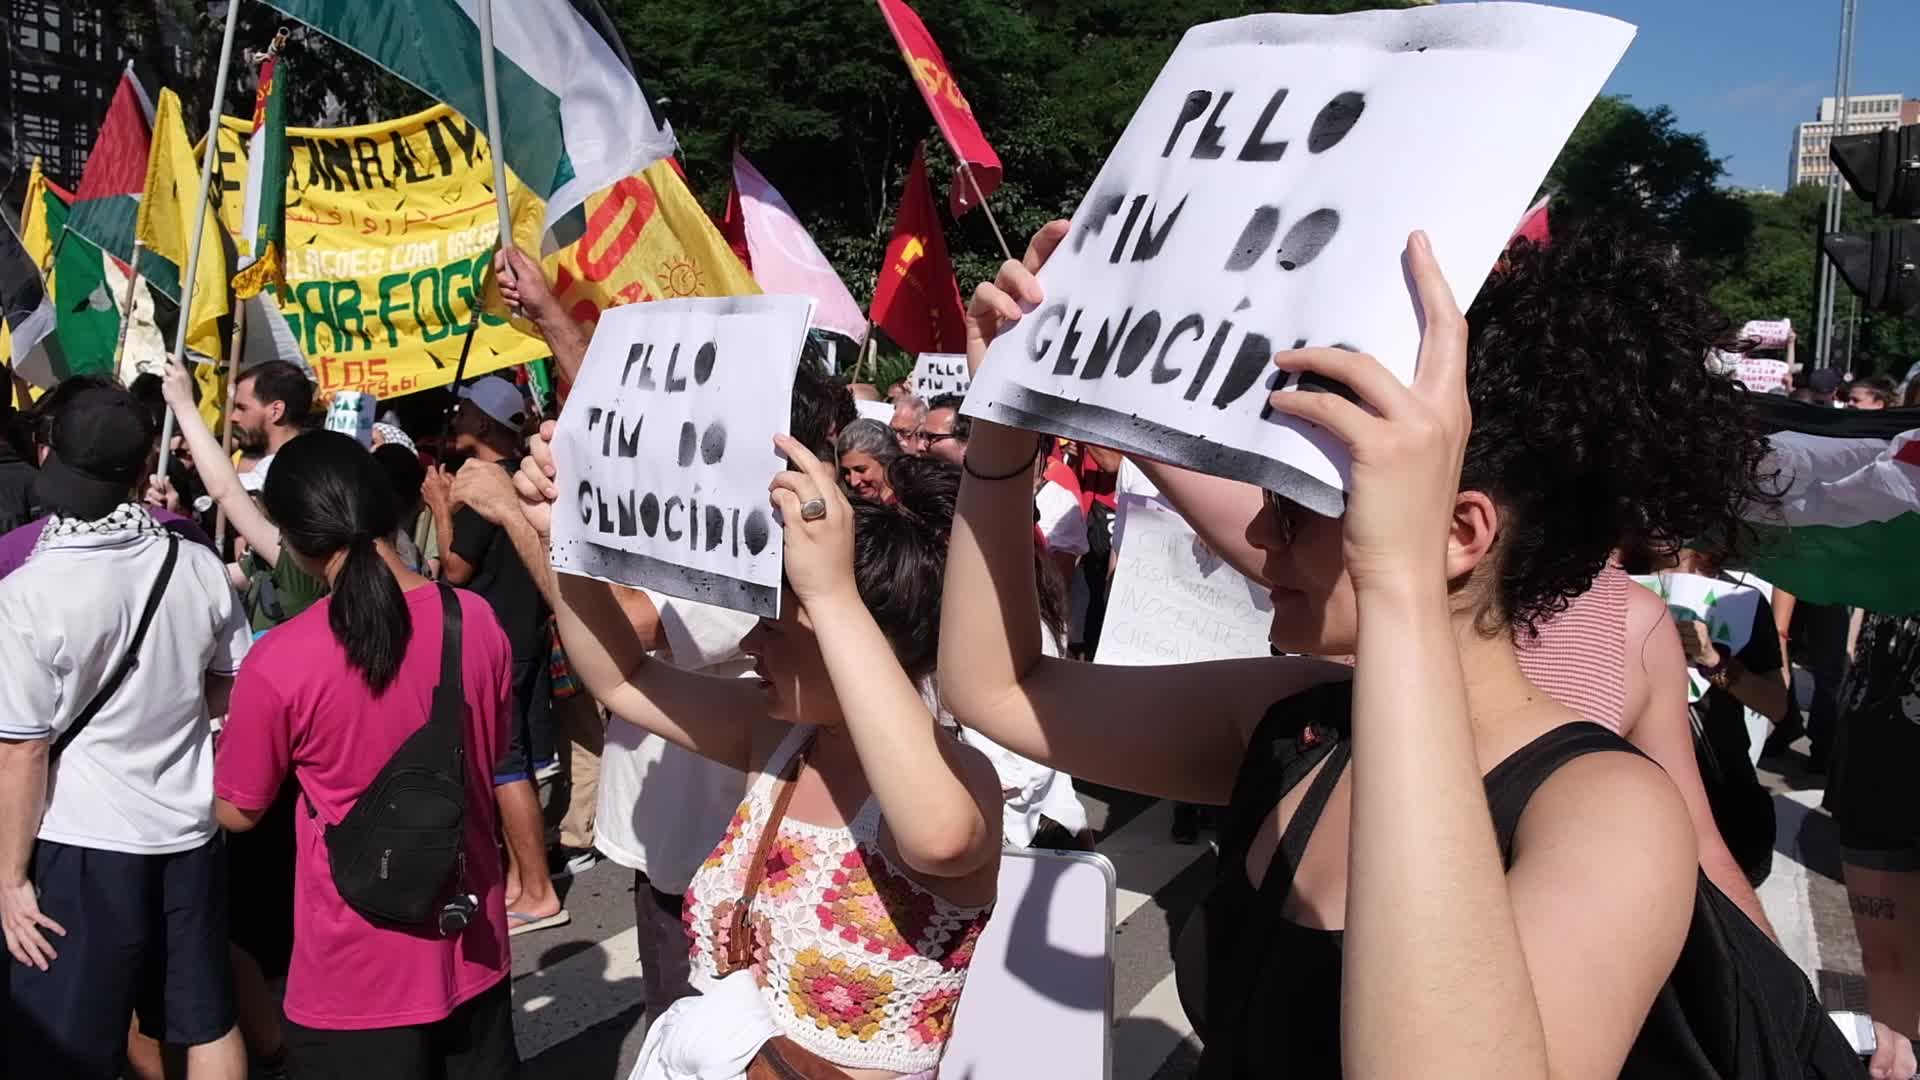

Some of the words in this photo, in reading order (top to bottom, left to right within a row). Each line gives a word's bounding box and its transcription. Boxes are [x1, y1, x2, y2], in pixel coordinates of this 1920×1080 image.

[1162, 89, 1366, 162] PELO
[1073, 192, 1189, 264] FIM
[1224, 205, 1342, 272] DO
[621, 336, 717, 393] PELO
[587, 407, 644, 457] FIM
[678, 418, 727, 468] DO
[577, 479, 770, 557] GENOCÍDIO
